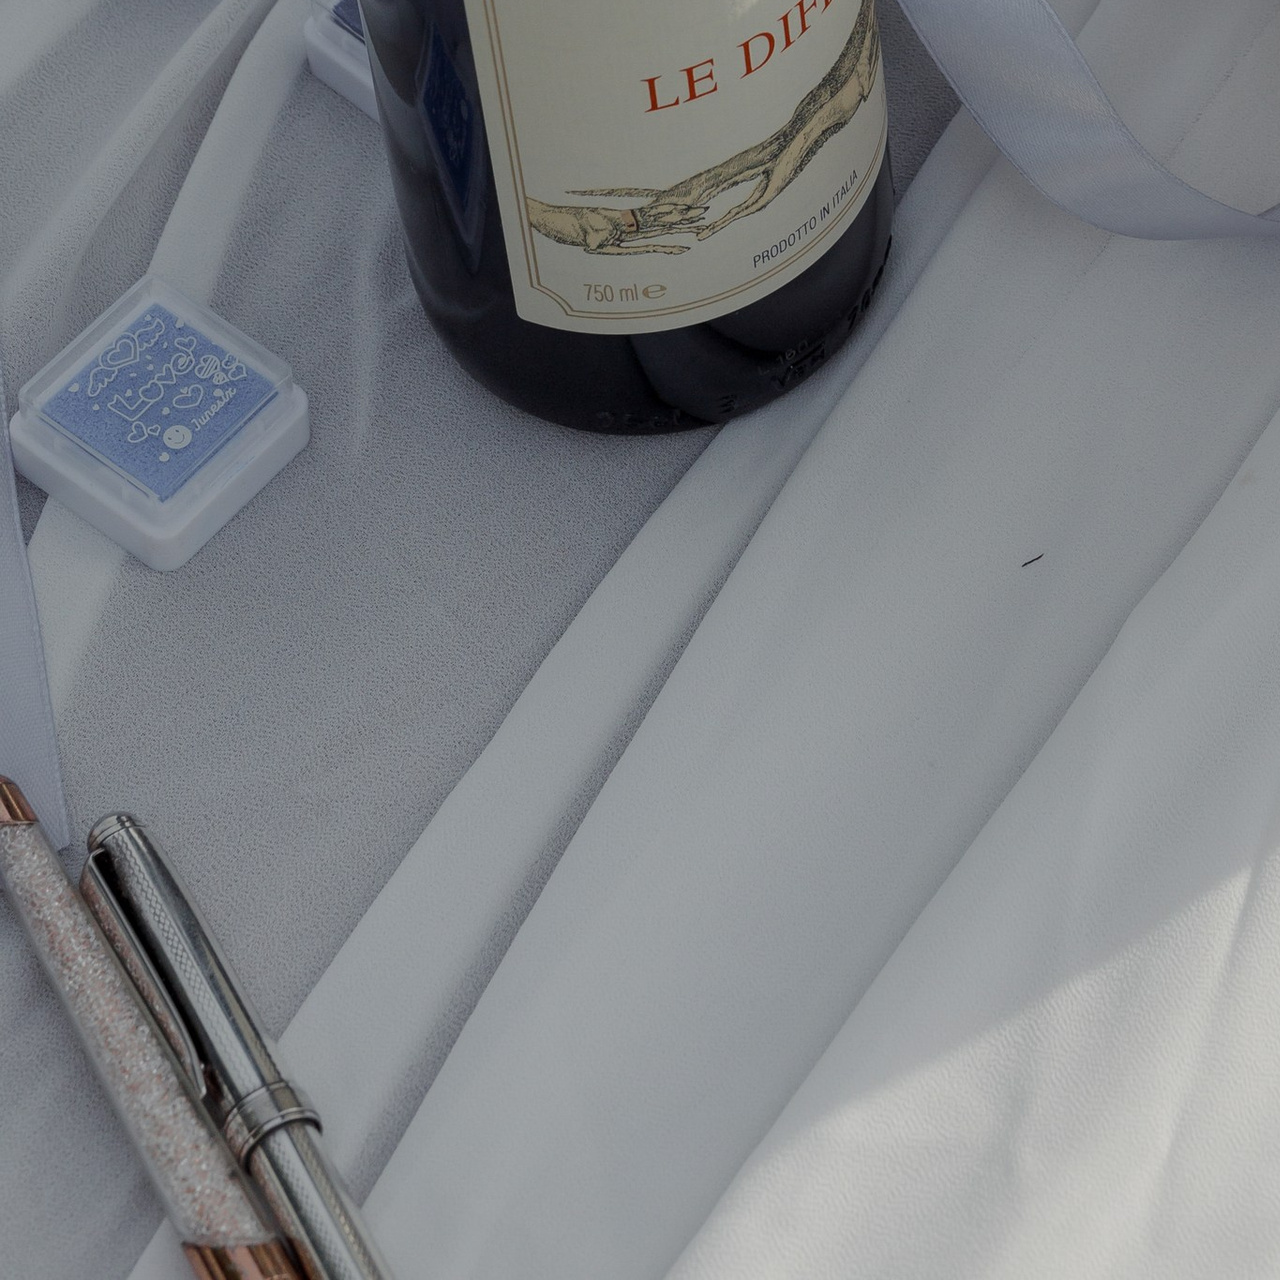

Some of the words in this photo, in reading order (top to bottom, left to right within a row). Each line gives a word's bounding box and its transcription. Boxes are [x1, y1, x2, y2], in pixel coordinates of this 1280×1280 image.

[639, 57, 719, 114] LE
[752, 214, 818, 269] PRODOTTO
[819, 203, 832, 223] IN
[831, 169, 859, 210] ITALIA
[583, 282, 616, 305] 750
[619, 282, 640, 303] ml
